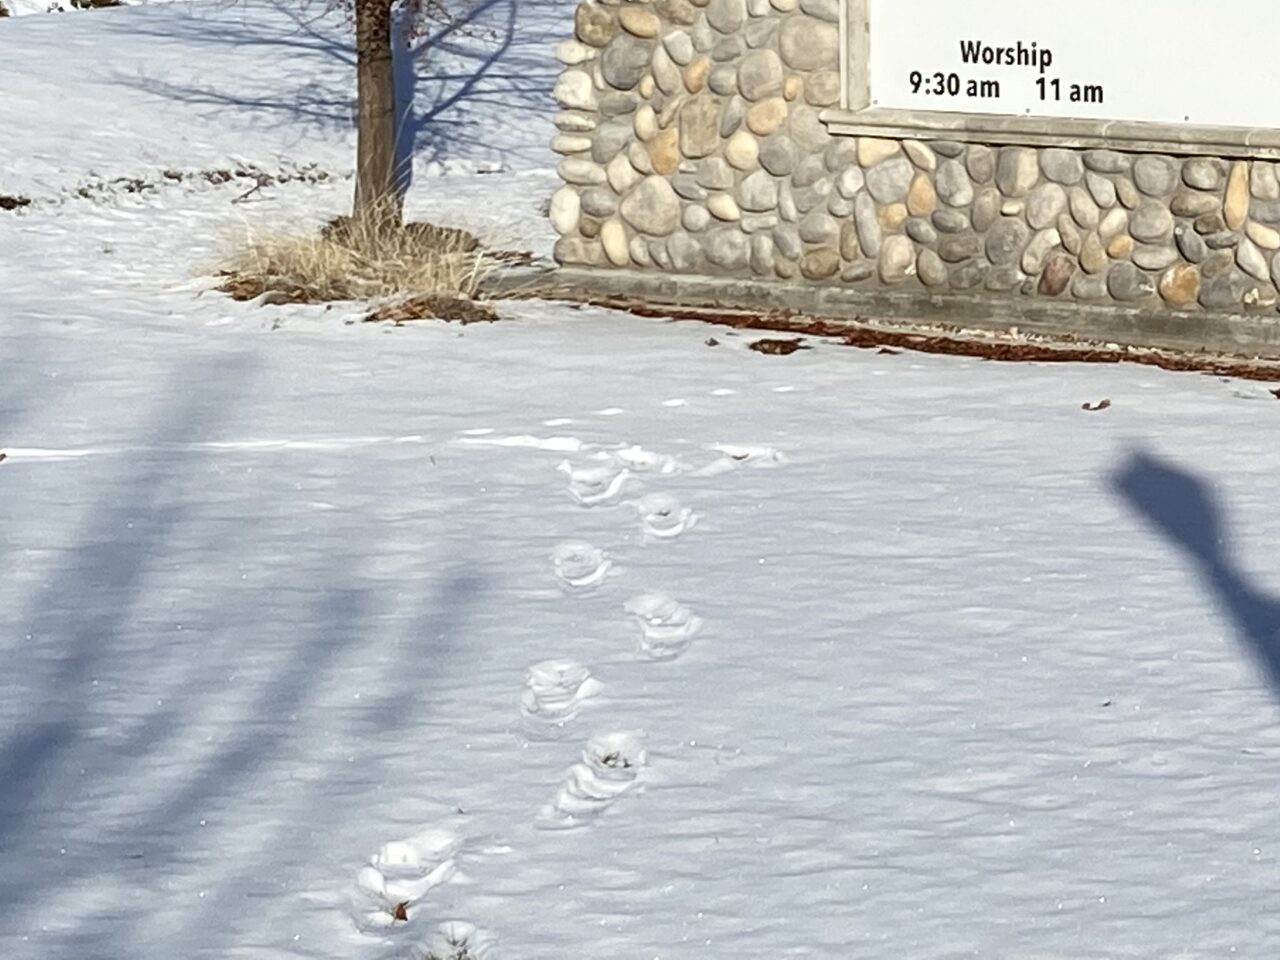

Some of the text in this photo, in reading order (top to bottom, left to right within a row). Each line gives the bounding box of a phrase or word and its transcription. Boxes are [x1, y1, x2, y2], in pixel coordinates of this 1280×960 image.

[960, 40, 1053, 74] Worship
[909, 70, 1104, 104] 9:30 am 11 am
